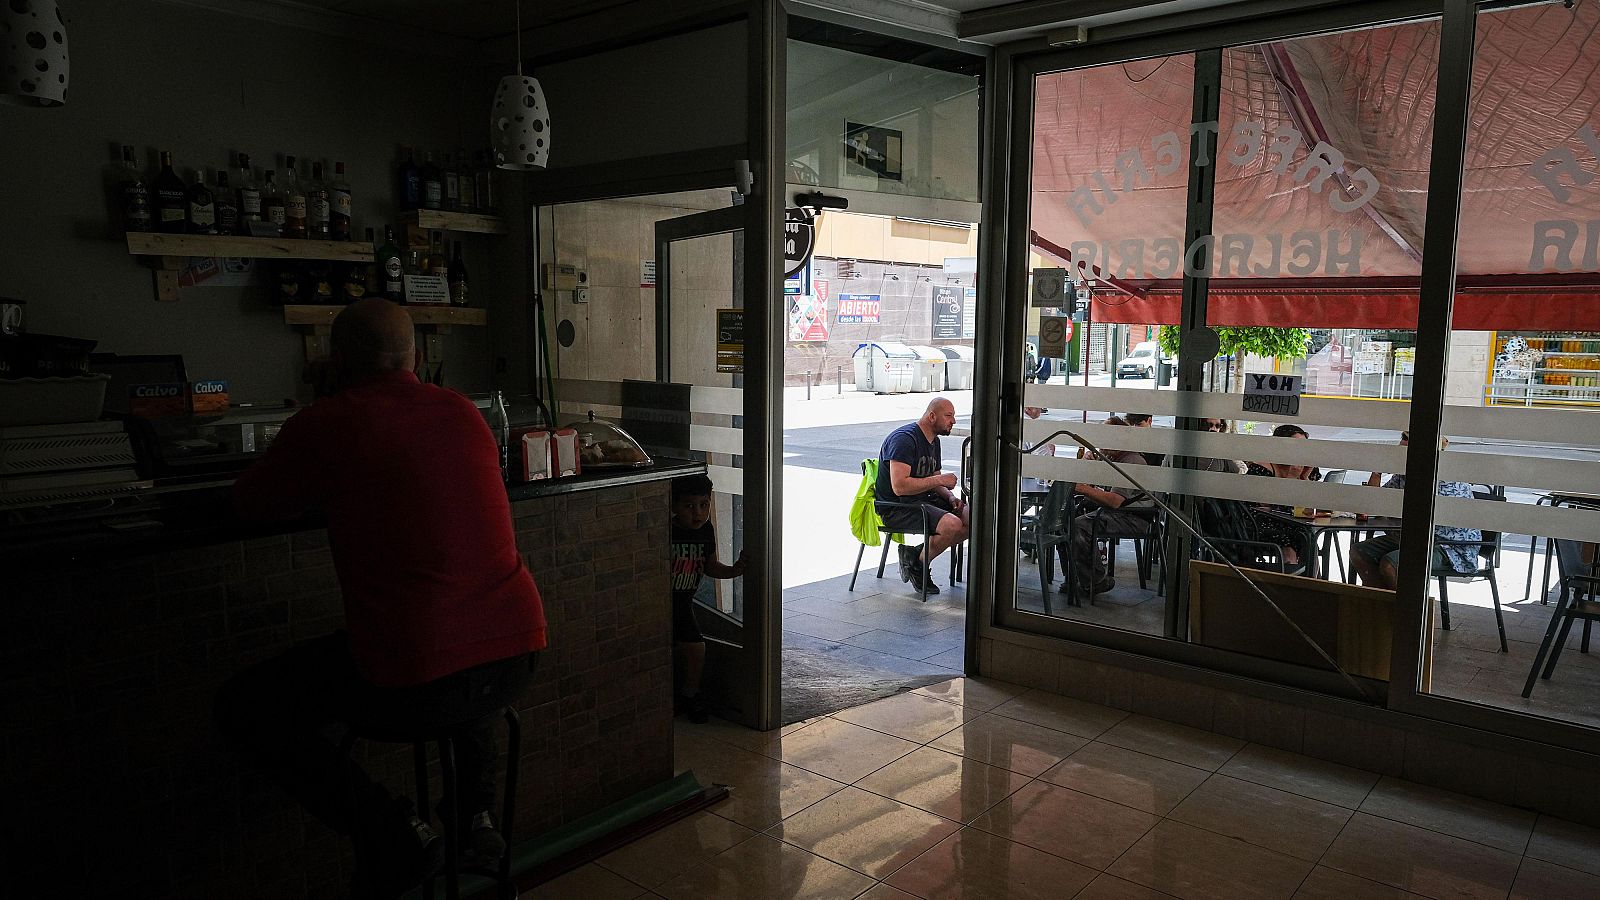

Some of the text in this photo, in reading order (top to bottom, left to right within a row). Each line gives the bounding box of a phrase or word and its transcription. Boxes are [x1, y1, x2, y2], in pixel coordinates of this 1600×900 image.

[839, 301, 879, 316] ABIERTO
[136, 385, 177, 397] Calvo
[195, 382, 223, 394] Calvo
